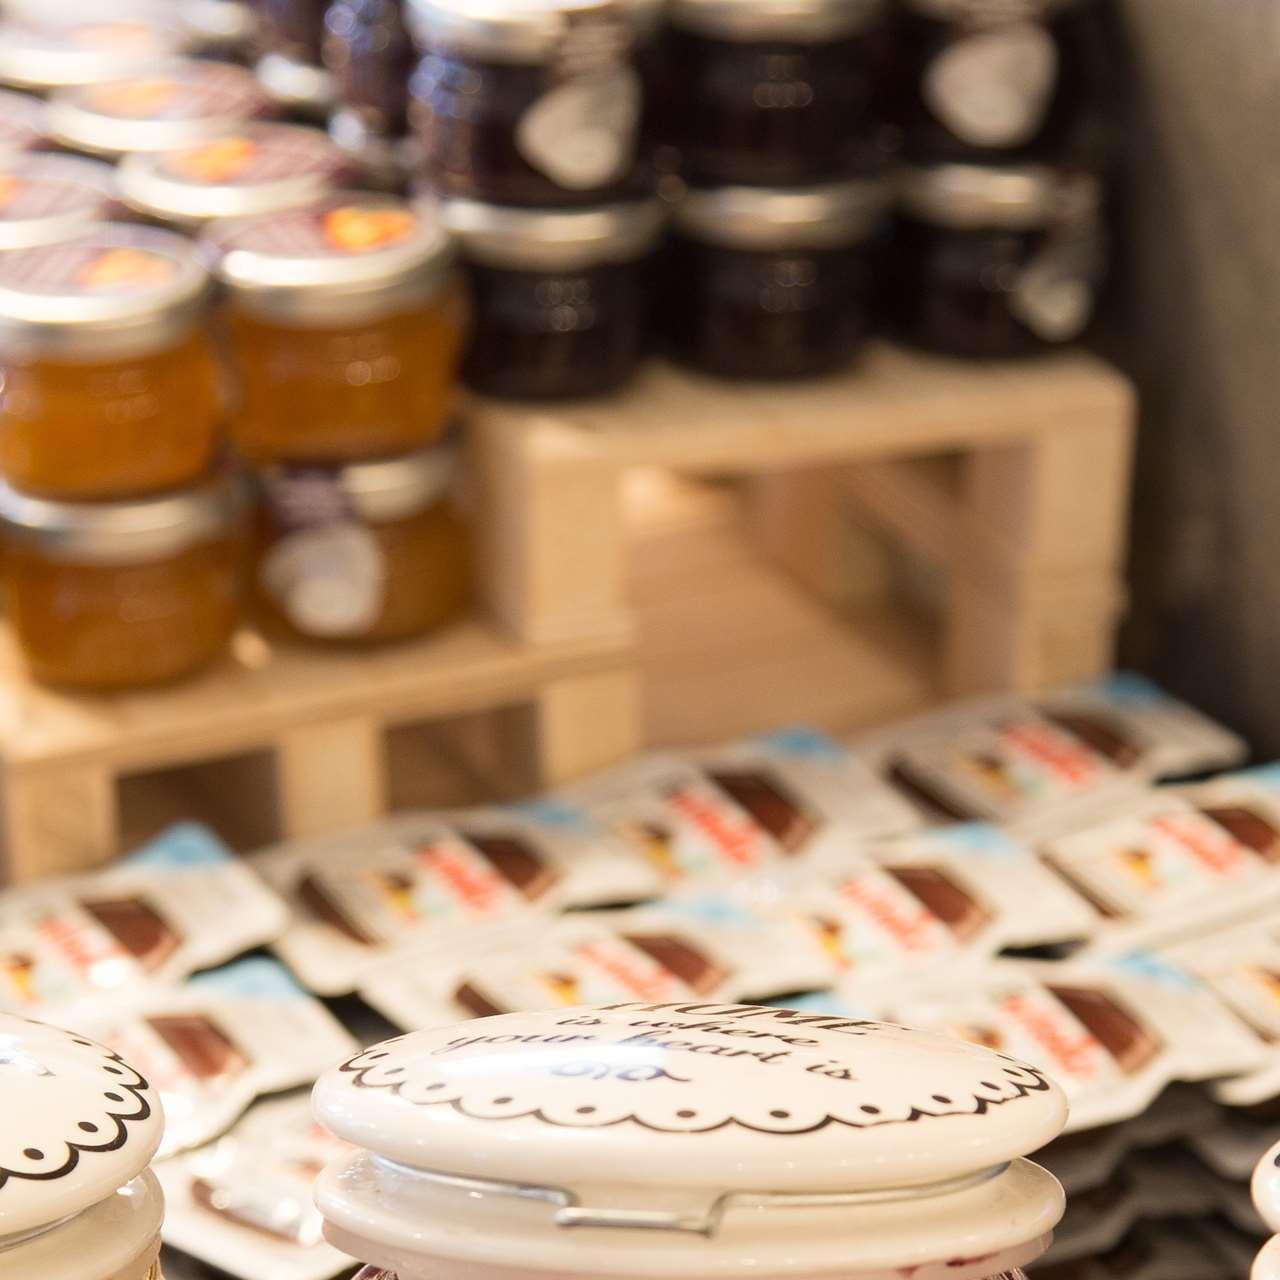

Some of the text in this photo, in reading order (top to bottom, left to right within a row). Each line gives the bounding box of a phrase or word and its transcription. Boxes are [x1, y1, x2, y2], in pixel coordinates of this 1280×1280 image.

[556, 1016, 820, 1047] is where
[431, 1035, 597, 1055] your
[805, 1059, 858, 1082] is
